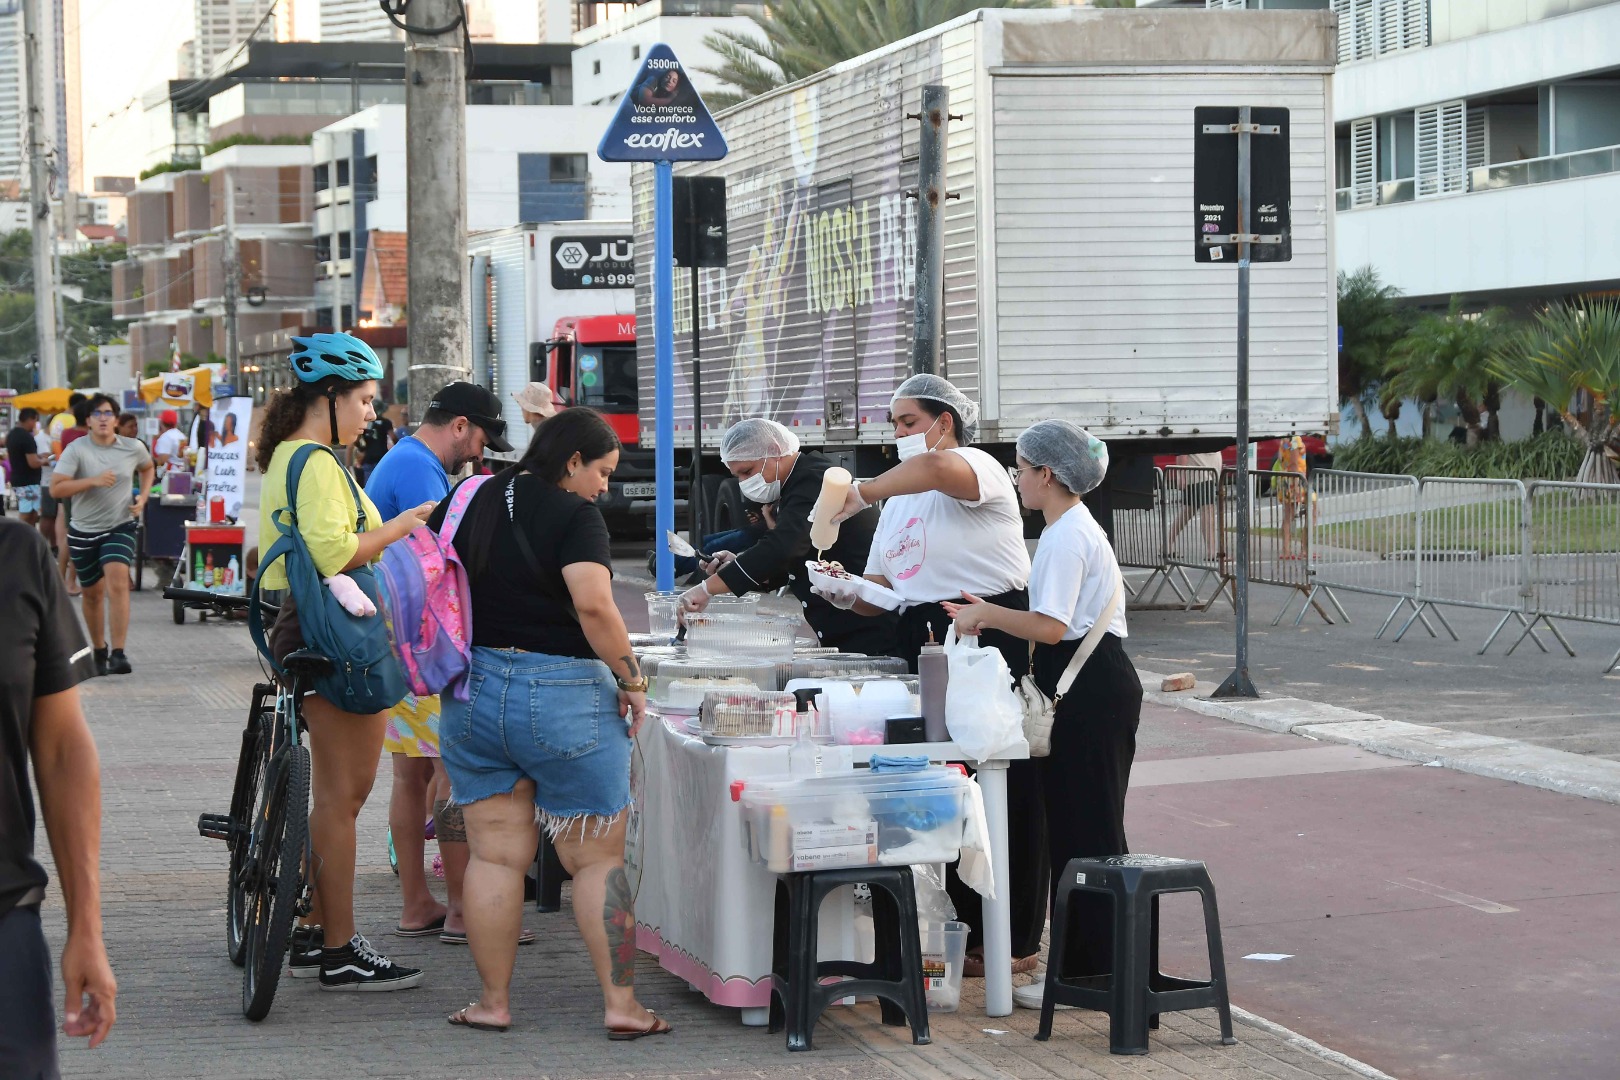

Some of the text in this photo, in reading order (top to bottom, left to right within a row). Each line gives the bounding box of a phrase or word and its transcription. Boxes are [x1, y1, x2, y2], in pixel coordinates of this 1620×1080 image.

[647, 59, 679, 69] 3500m
[634, 103, 693, 113] Você merece
[631, 113, 696, 123] esse conforto
[623, 127, 705, 152] ecoflex
[1200, 203, 1225, 212] Novembro
[805, 199, 875, 315] NOSSA
[594, 275, 605, 283] 83
